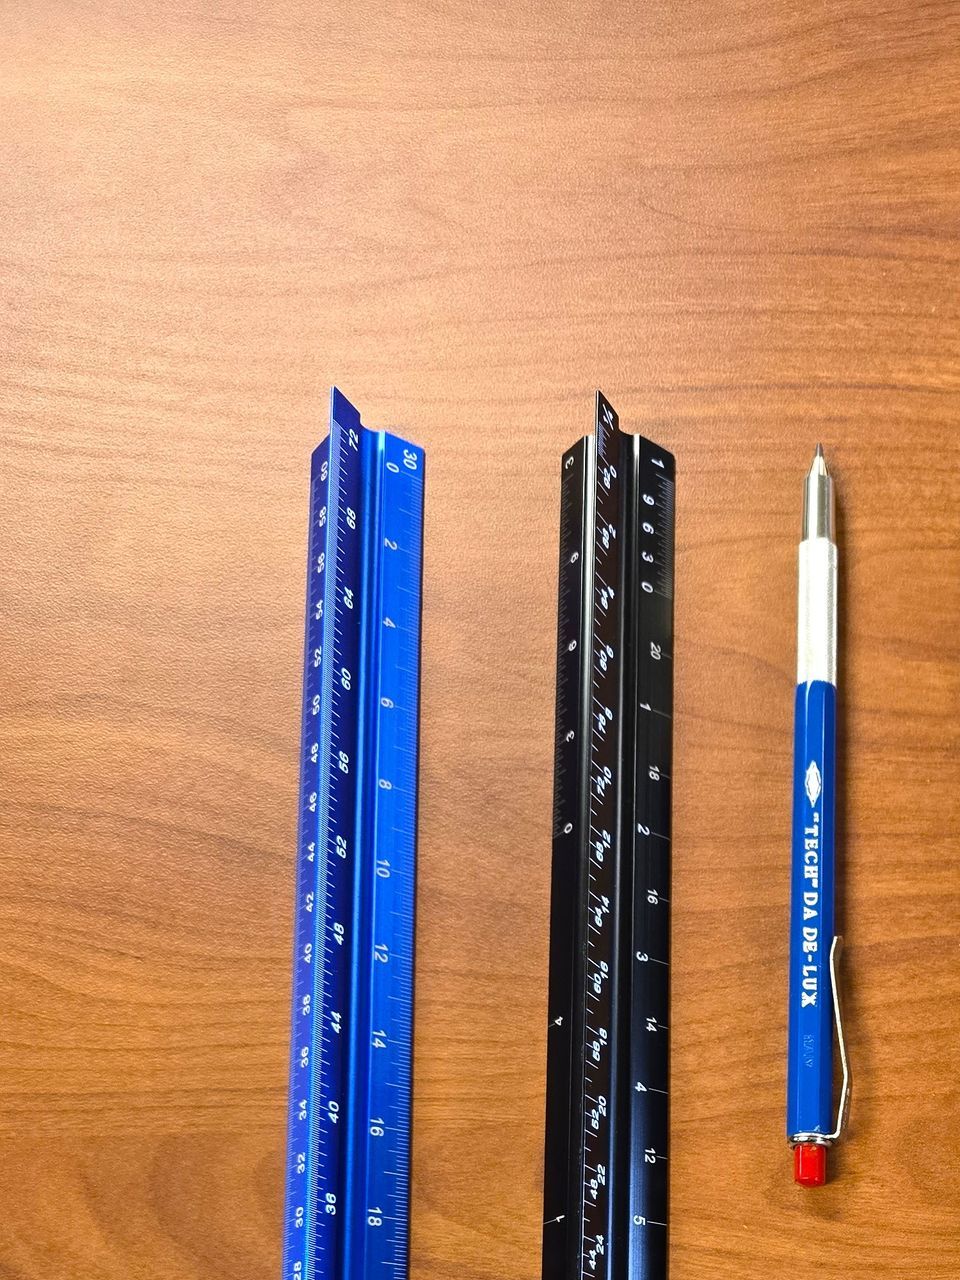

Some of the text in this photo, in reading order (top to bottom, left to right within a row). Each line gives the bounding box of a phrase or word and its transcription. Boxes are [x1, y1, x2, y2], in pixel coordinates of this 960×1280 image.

[804, 892, 818, 920] DA
[802, 927, 817, 1007] DE-LUX
[331, 1011, 341, 1033] 44
[372, 1031, 386, 1048] 14
[328, 1101, 339, 1123] 40
[368, 1207, 382, 1226] 18
